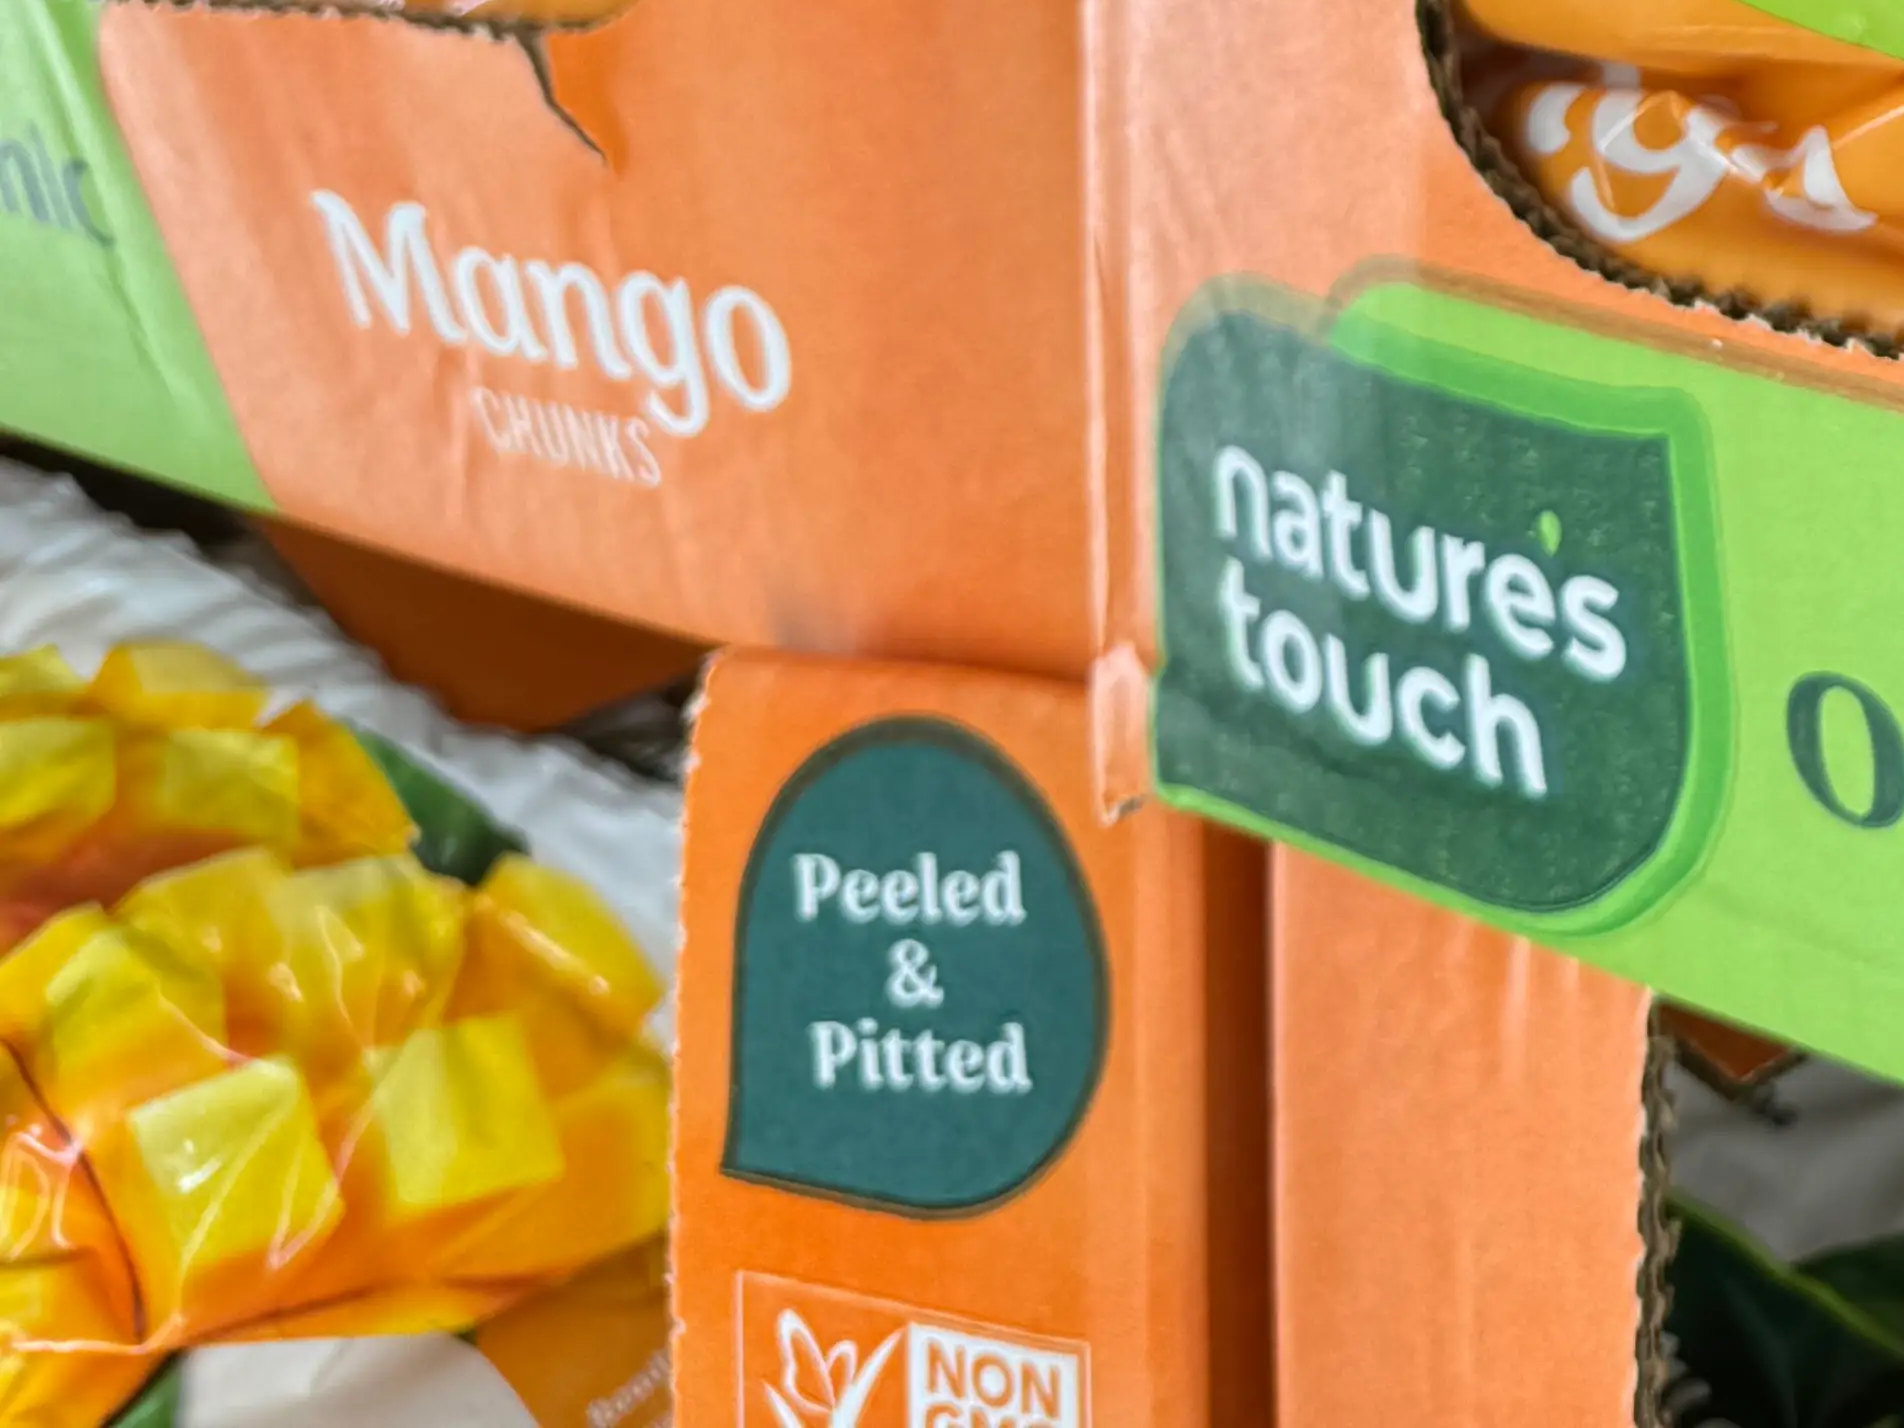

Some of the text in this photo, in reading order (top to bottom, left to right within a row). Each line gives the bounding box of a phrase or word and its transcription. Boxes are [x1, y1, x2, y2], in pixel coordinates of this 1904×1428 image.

[311, 189, 792, 438] Mango
[471, 385, 662, 489] CHUNKS
[1213, 444, 1627, 684] nature's
[1216, 556, 1548, 800] touch
[792, 850, 1027, 929] Peeled
[885, 940, 943, 1008] &
[810, 1019, 1031, 1096] Pitted
[926, 1338, 1060, 1419] NON
